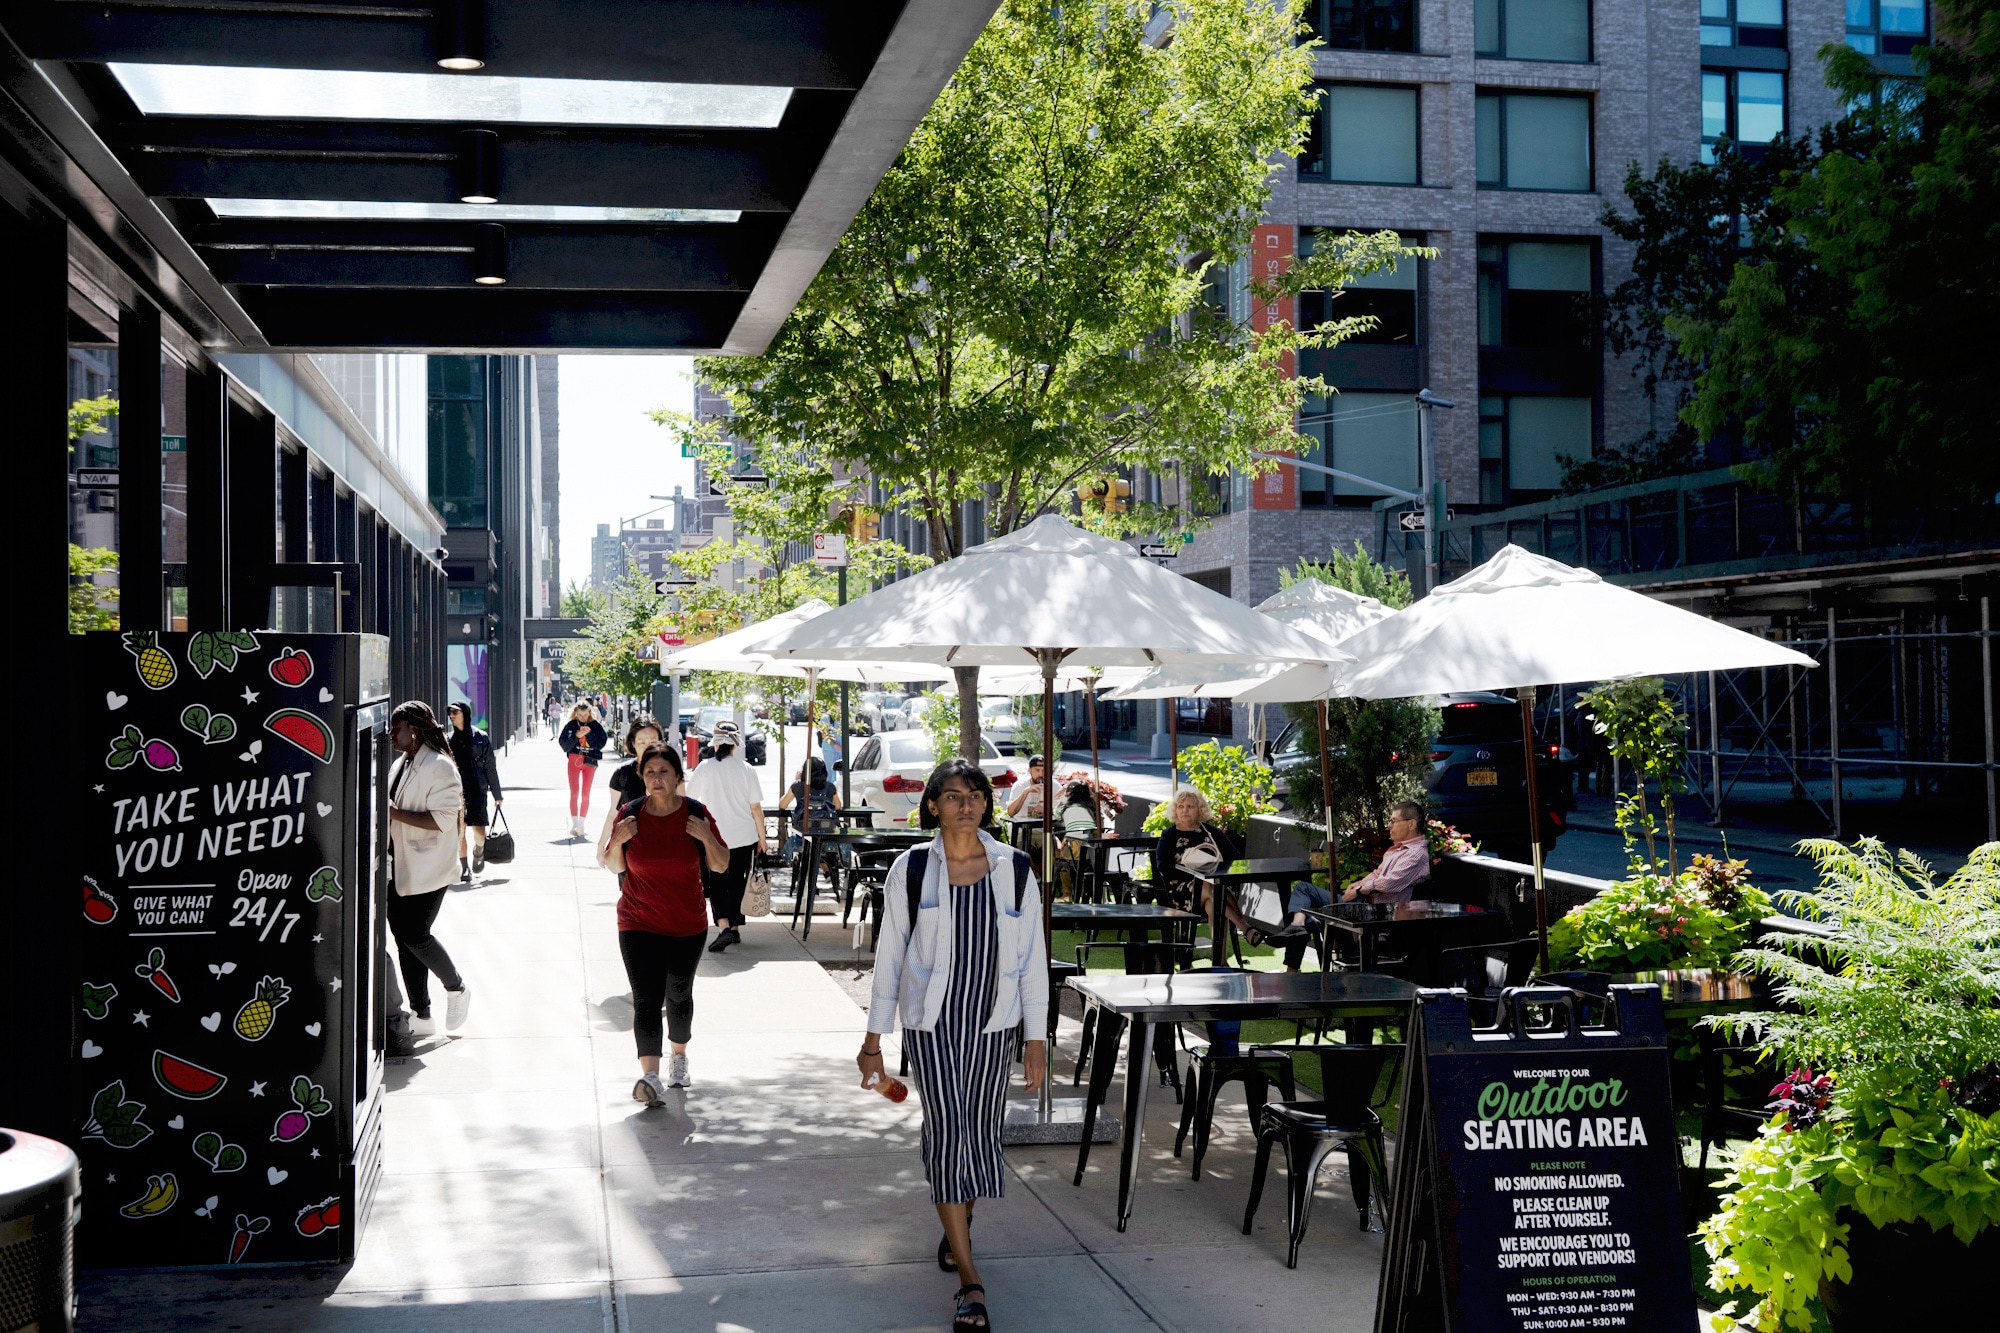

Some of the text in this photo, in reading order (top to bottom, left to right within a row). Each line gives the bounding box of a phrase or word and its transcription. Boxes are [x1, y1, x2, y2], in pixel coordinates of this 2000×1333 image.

[1266, 260, 1279, 325] REALS
[1407, 517, 1424, 526] ONE
[548, 648, 568, 657] VITA
[113, 772, 311, 834] TAKE WHAT
[115, 812, 305, 877] YOU NEED!
[237, 869, 292, 893] Open
[134, 895, 213, 911] GIVE WHAT
[137, 911, 204, 925] YOU CAN!
[229, 897, 300, 943] 24/7
[1513, 1069, 1590, 1078] WELCOME TO OUR
[1477, 1075, 1629, 1121] Outdoor
[1463, 1117, 1648, 1150] SEATING AREA
[1530, 1161, 1586, 1170] PLEASE NOTE
[1494, 1174, 1625, 1191] NO SMOKING ALLOWED.
[1512, 1196, 1610, 1212] PLEASE CLEAN UP
[1514, 1212, 1612, 1229] AFTER YOURSELF.
[1499, 1233, 1630, 1252] WE ENCOURAGE YOU TO
[1497, 1249, 1636, 1268] SUPPORT OUR VENDORS!
[1522, 1275, 1616, 1286] HOURS OF OPERATION
[1506, 1293, 1529, 1302] MON
[1536, 1292, 1559, 1301] WED:
[1560, 1291, 1578, 1300] 9:30
[1580, 1290, 1595, 1299] AM
[1602, 1289, 1620, 1298] 7:30
[1621, 1288, 1636, 1297] PM
[1511, 1307, 1531, 1316] THU
[1538, 1306, 1557, 1315] SAT:
[1558, 1305, 1576, 1314] 9:30
[1578, 1304, 1593, 1313] AM
[1600, 1303, 1619, 1312] 8:30
[1619, 1302, 1634, 1311] PM
[1523, 1320, 1544, 1329] SUN:
[1545, 1319, 1568, 1328] 10:00
[1570, 1319, 1585, 1327] AM
[1592, 1318, 1610, 1326] 5:30
[1611, 1317, 1626, 1325] PM
